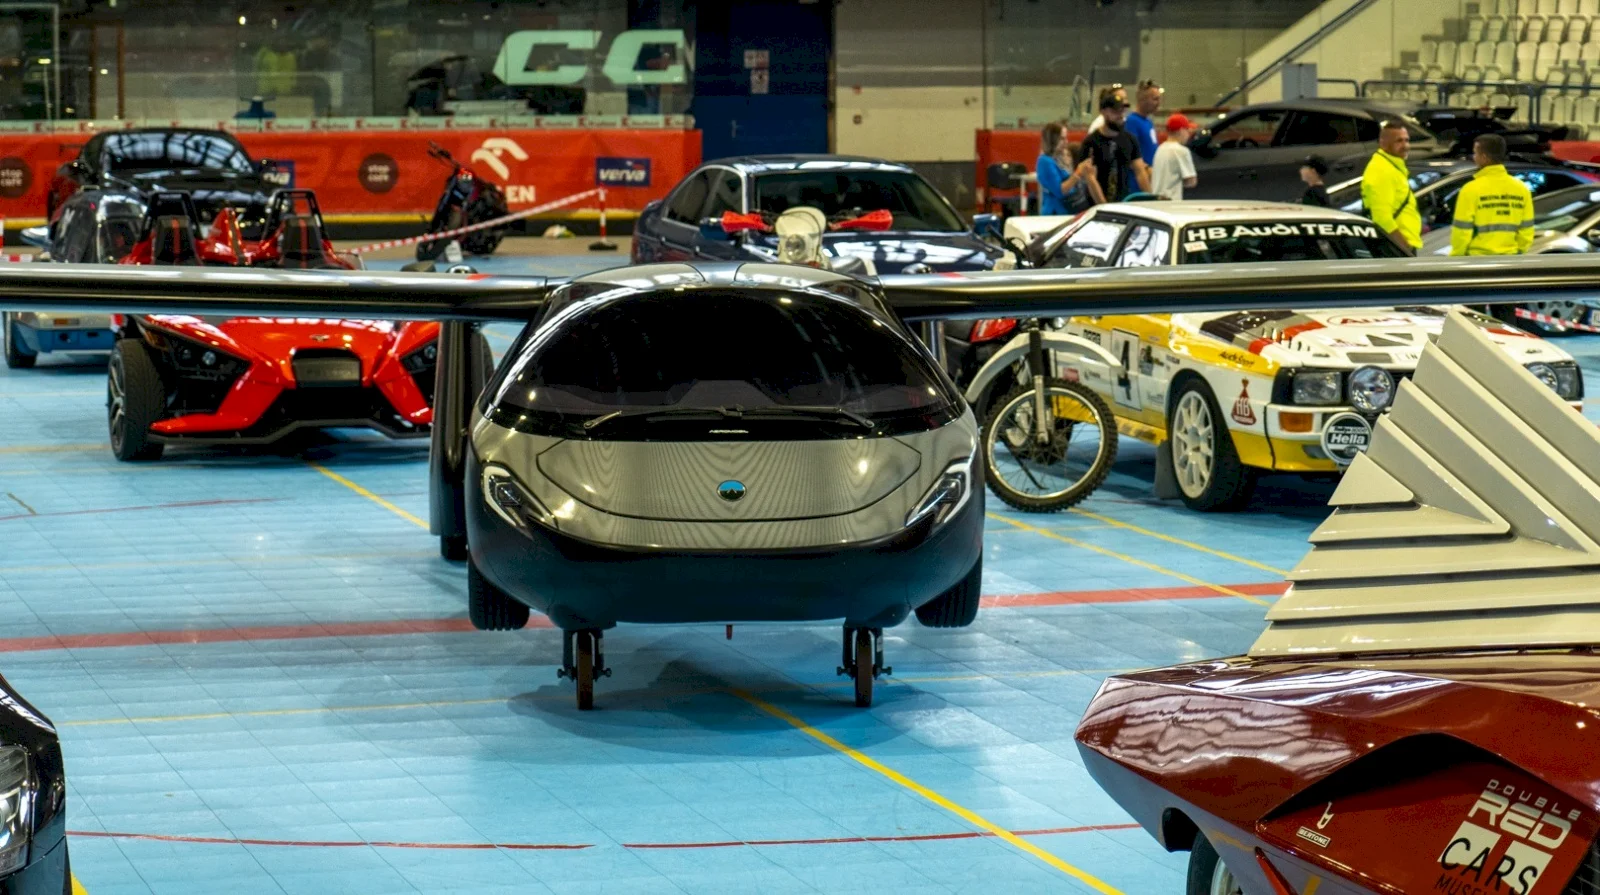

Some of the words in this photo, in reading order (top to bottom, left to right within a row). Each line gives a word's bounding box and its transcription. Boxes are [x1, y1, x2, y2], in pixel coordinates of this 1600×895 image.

[600, 168, 646, 182] verva
[1187, 227, 1228, 241] HB
[1301, 223, 1379, 238] TEAM
[1236, 397, 1250, 416] HB
[1331, 433, 1366, 444] Hella
[1486, 779, 1582, 821] DOUBLE
[1467, 789, 1572, 850] RED
[1299, 828, 1328, 845] BERTONE
[1441, 837, 1538, 895] CARS
